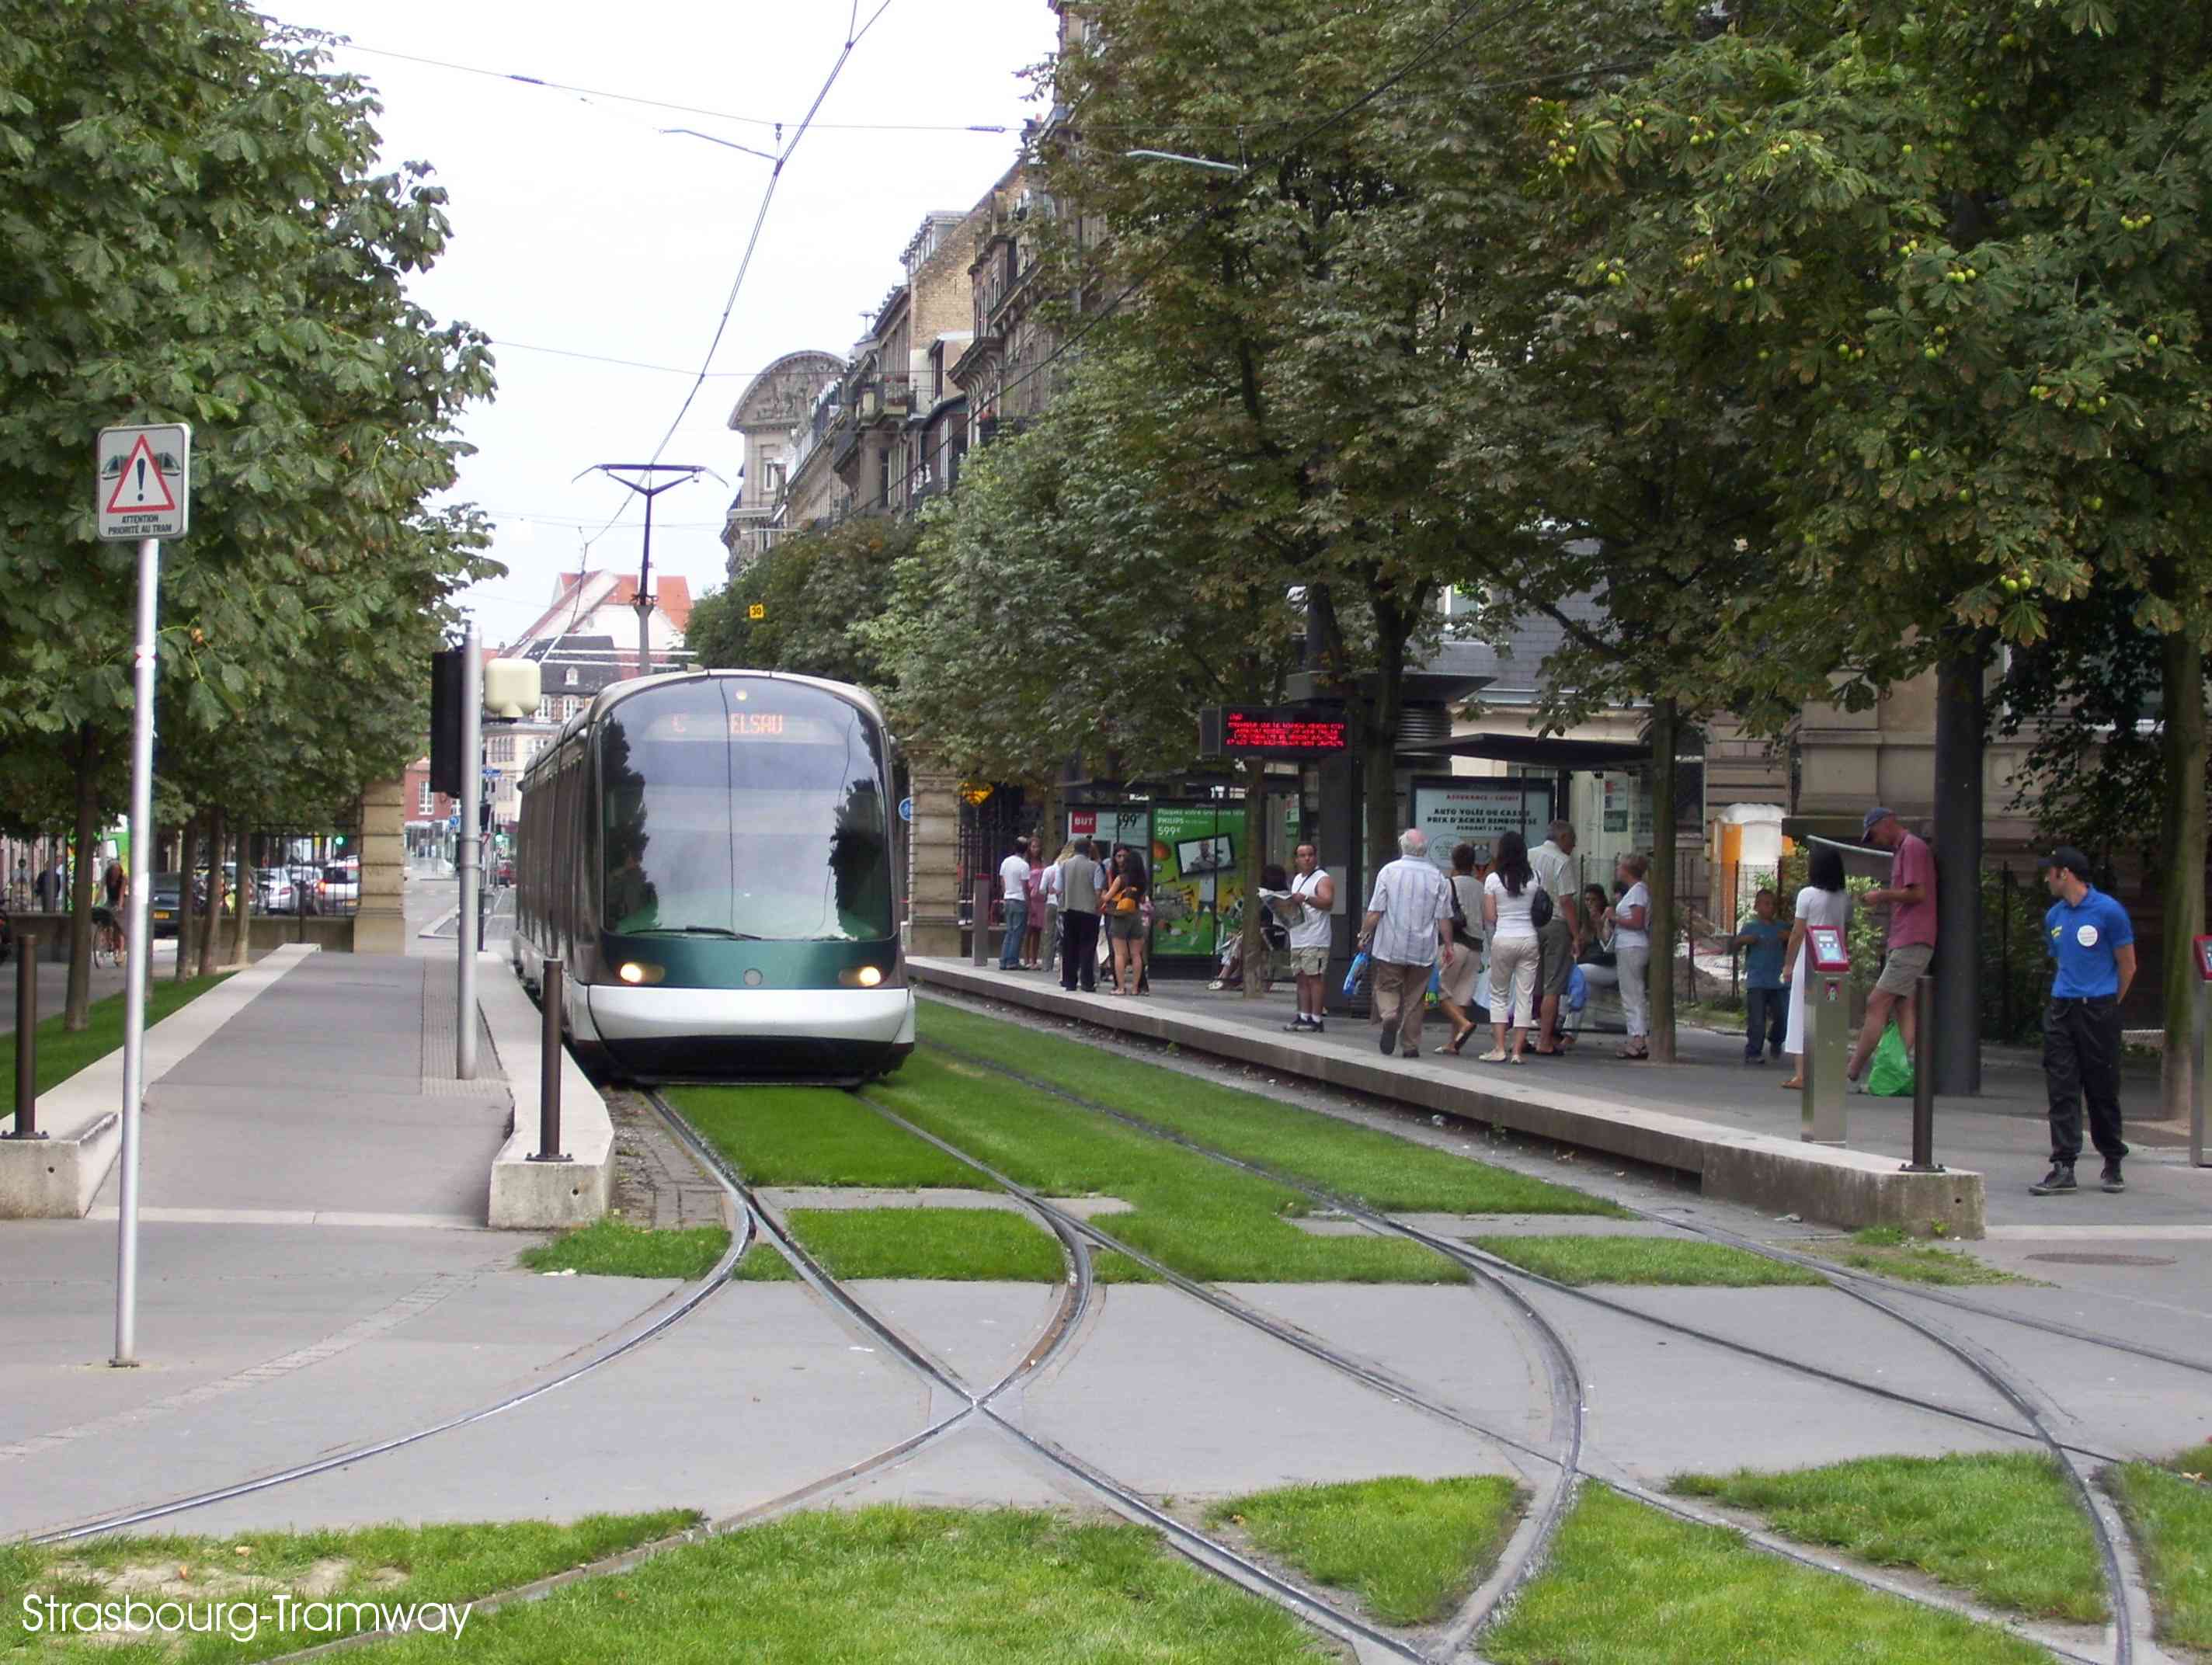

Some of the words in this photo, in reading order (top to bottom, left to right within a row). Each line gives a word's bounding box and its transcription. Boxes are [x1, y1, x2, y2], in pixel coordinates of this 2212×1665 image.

[122, 514, 159, 523] ATTENTION
[141, 524, 151, 534] AU
[153, 523, 172, 533] TRAM
[751, 607, 762, 616] 30
[671, 714, 687, 733] C
[730, 712, 783, 734] ELSAU
[1074, 816, 1094, 826] BUT
